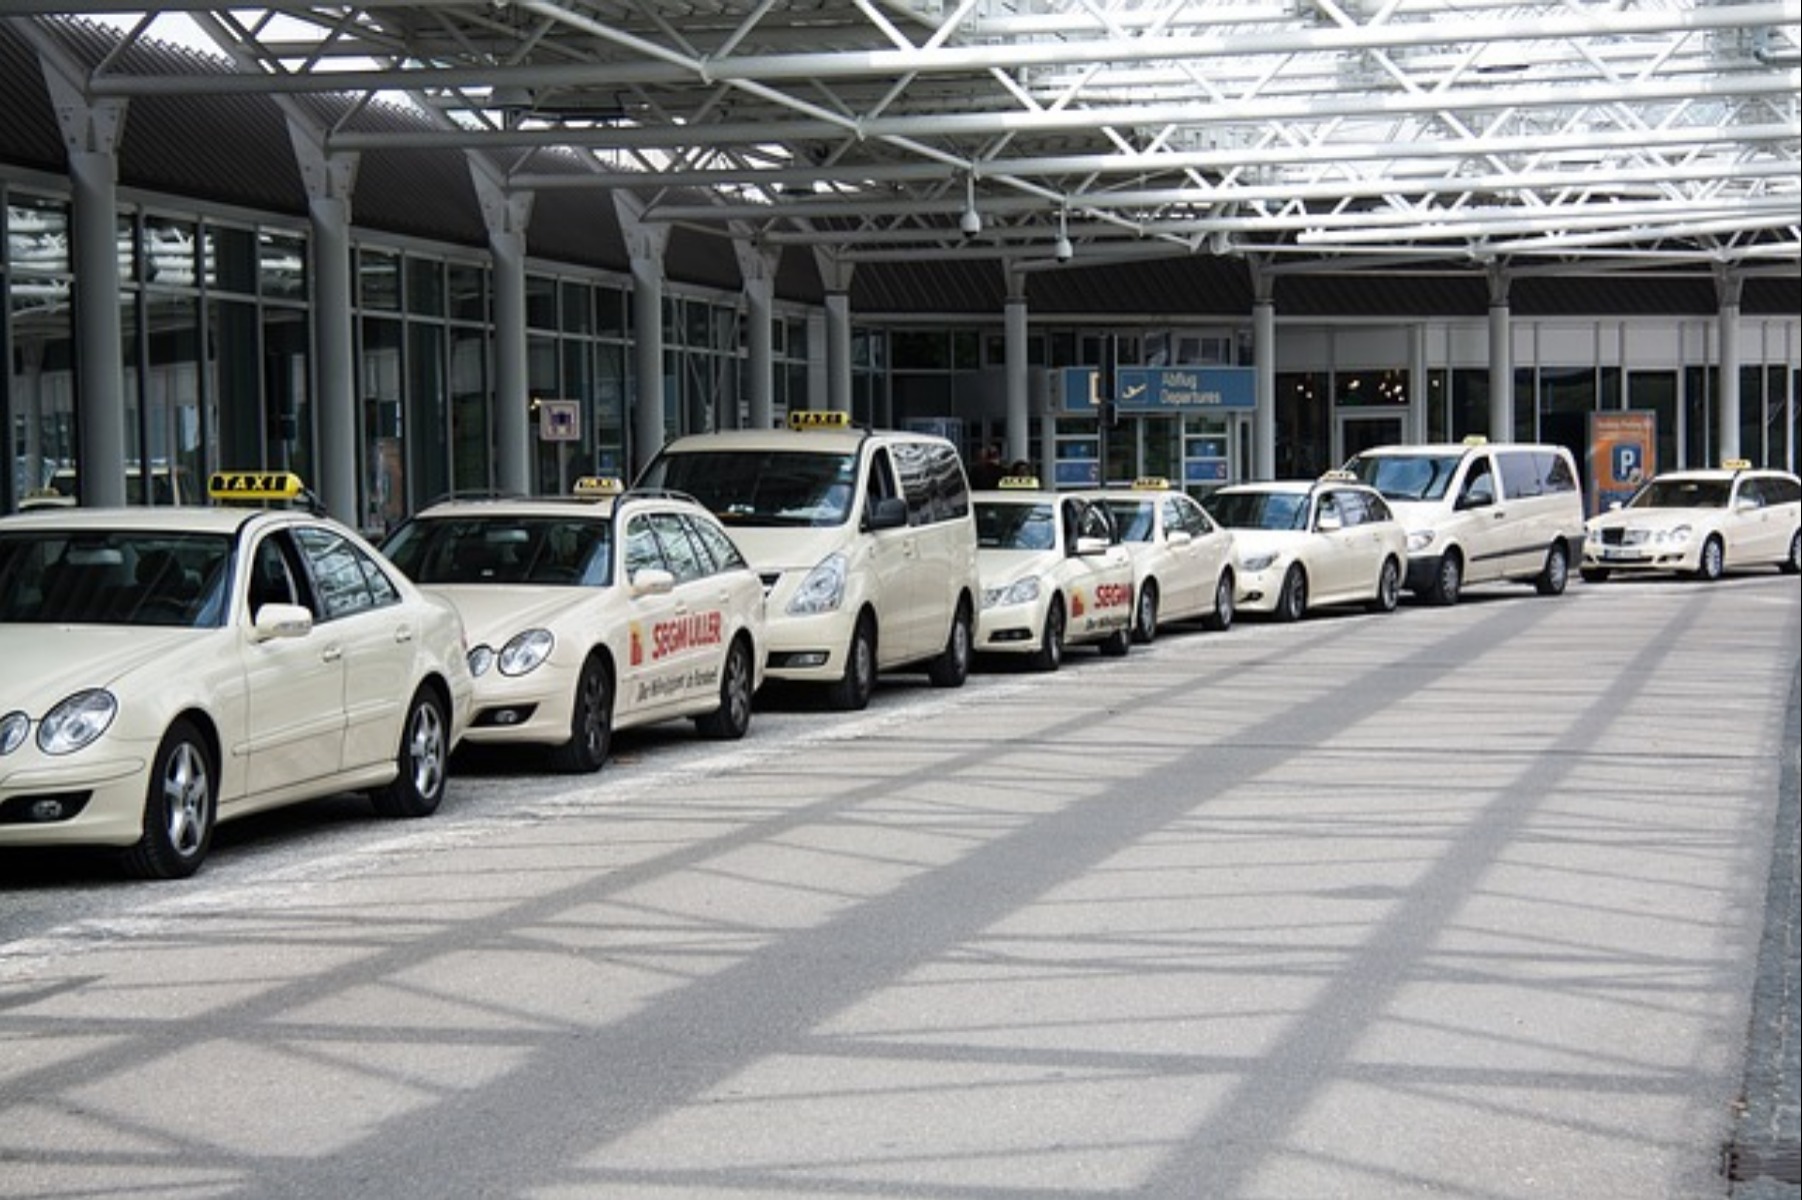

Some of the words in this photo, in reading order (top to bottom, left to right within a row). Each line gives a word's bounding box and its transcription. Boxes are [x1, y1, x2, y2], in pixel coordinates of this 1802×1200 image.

[1161, 372, 1198, 390] Abflug
[1159, 389, 1222, 406] Departures
[1620, 450, 1636, 477] P
[213, 475, 286, 492] TAXI
